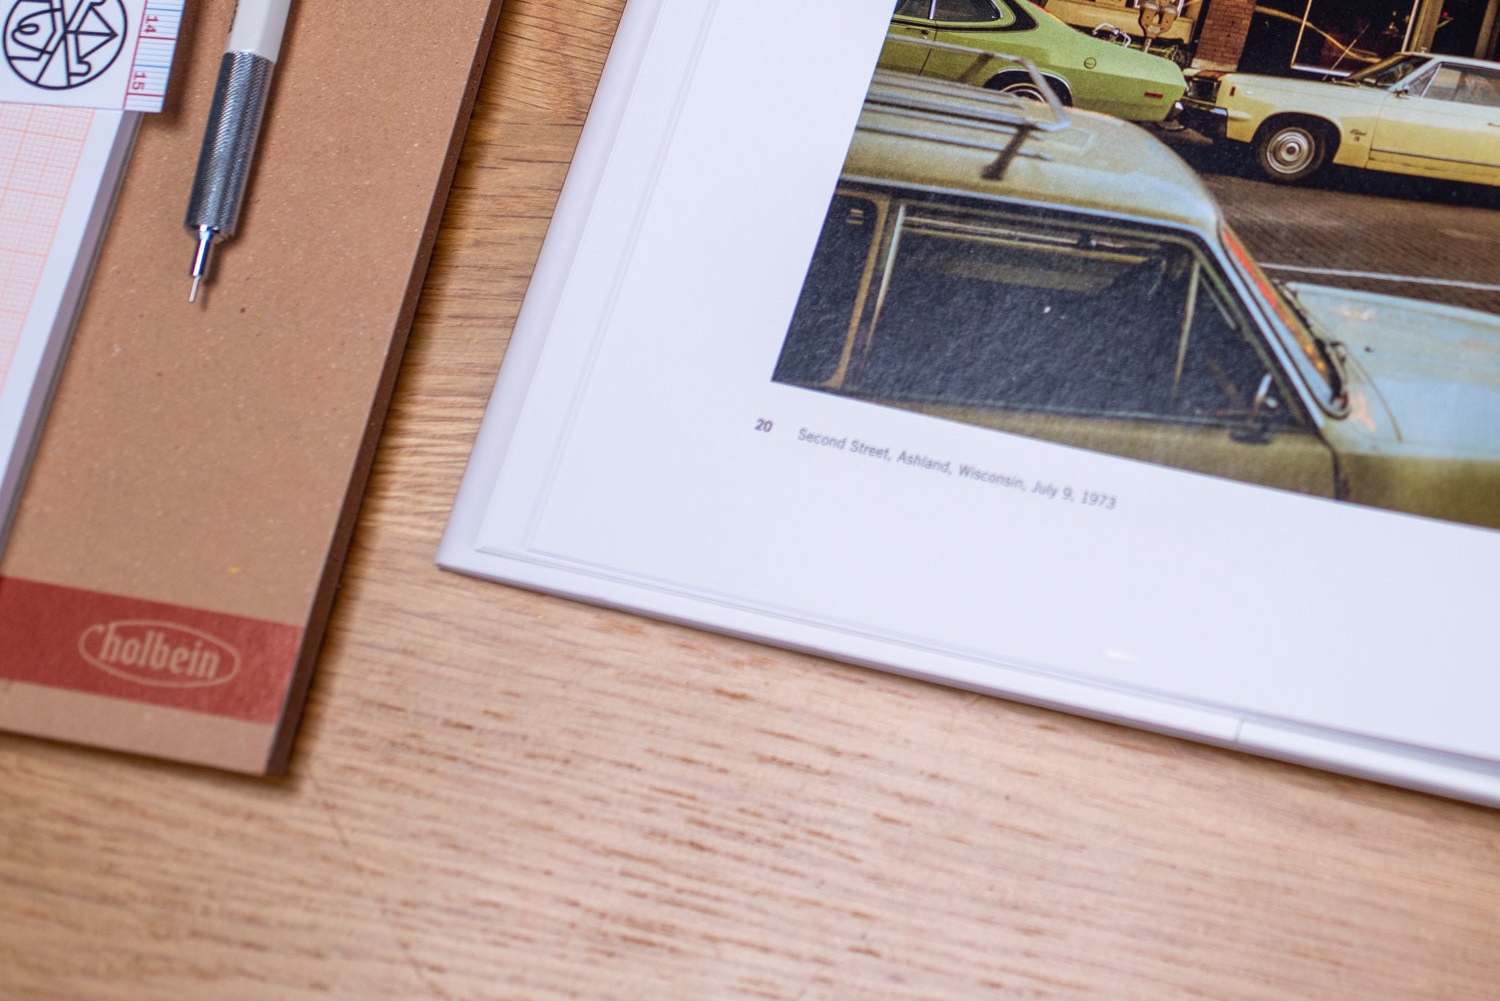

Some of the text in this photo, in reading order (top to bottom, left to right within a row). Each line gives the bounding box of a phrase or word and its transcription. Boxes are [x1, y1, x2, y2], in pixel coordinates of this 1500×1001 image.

[144, 15, 159, 34] 14
[132, 71, 146, 92] 15
[755, 418, 1118, 510] 20 Second Street, Ashland, Wisconsin, July 9, 1973
[99, 623, 220, 680] holbein
